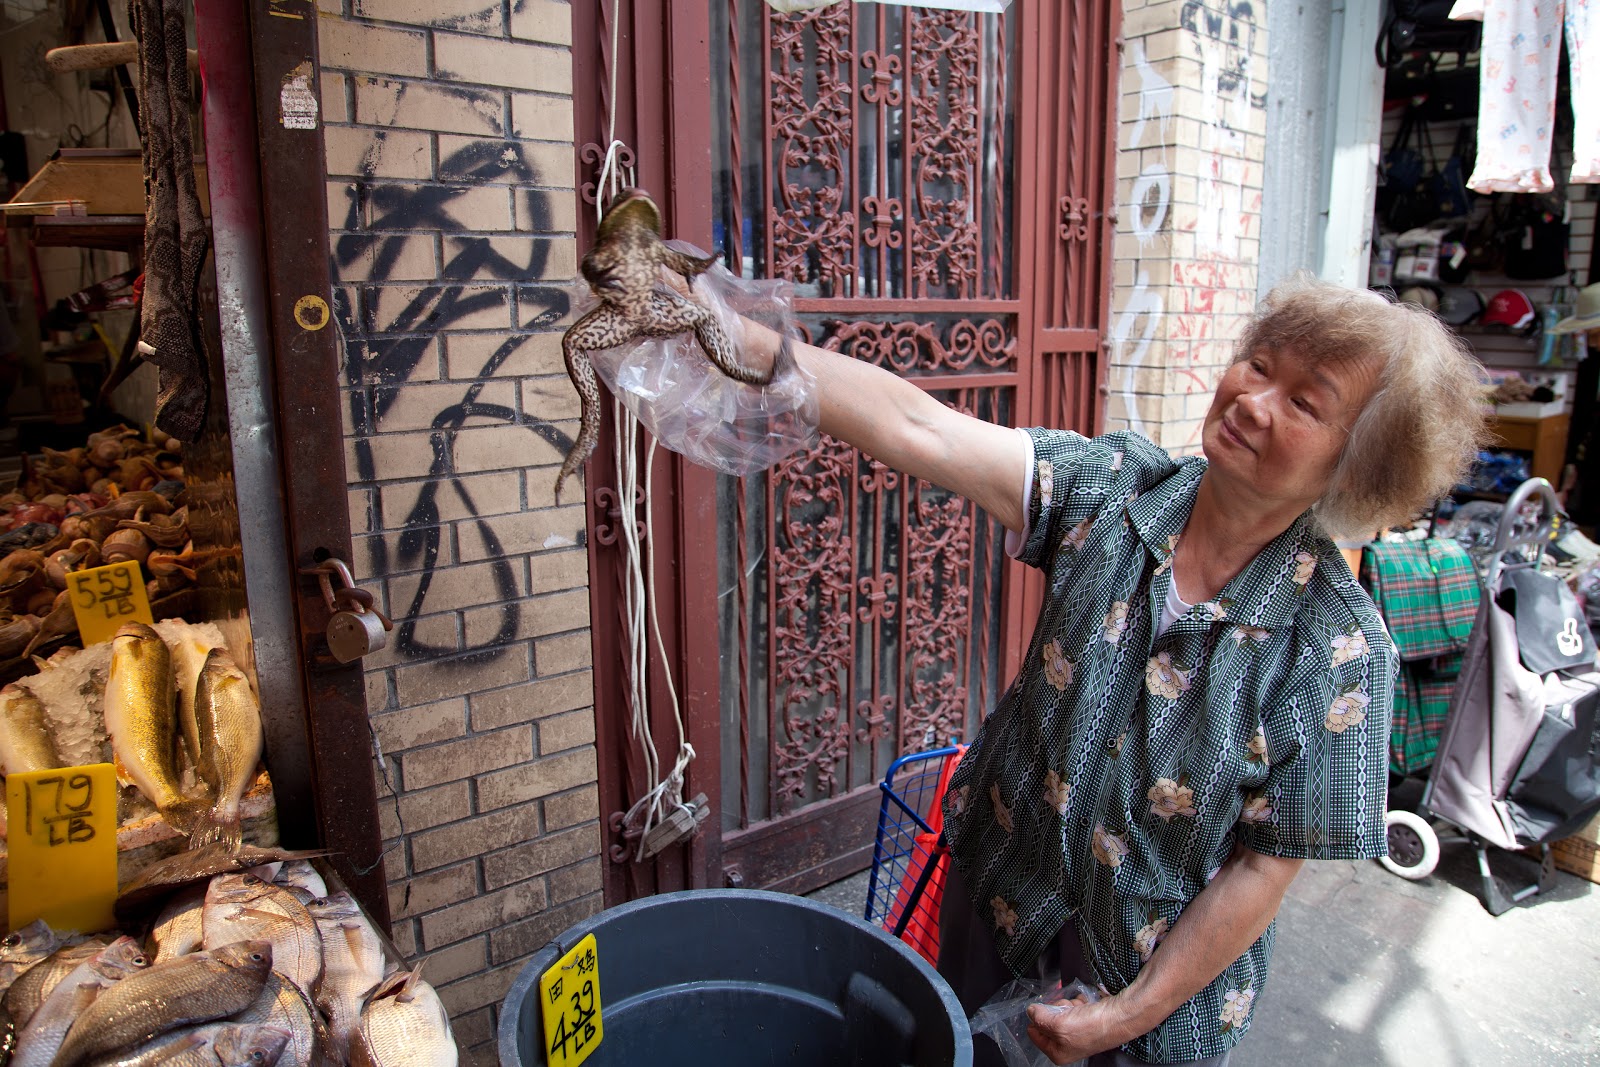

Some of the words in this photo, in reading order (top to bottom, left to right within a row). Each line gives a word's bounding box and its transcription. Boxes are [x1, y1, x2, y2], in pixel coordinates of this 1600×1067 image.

[105, 598, 136, 619] LB
[49, 817, 96, 848] LB
[574, 1021, 596, 1054] LB
